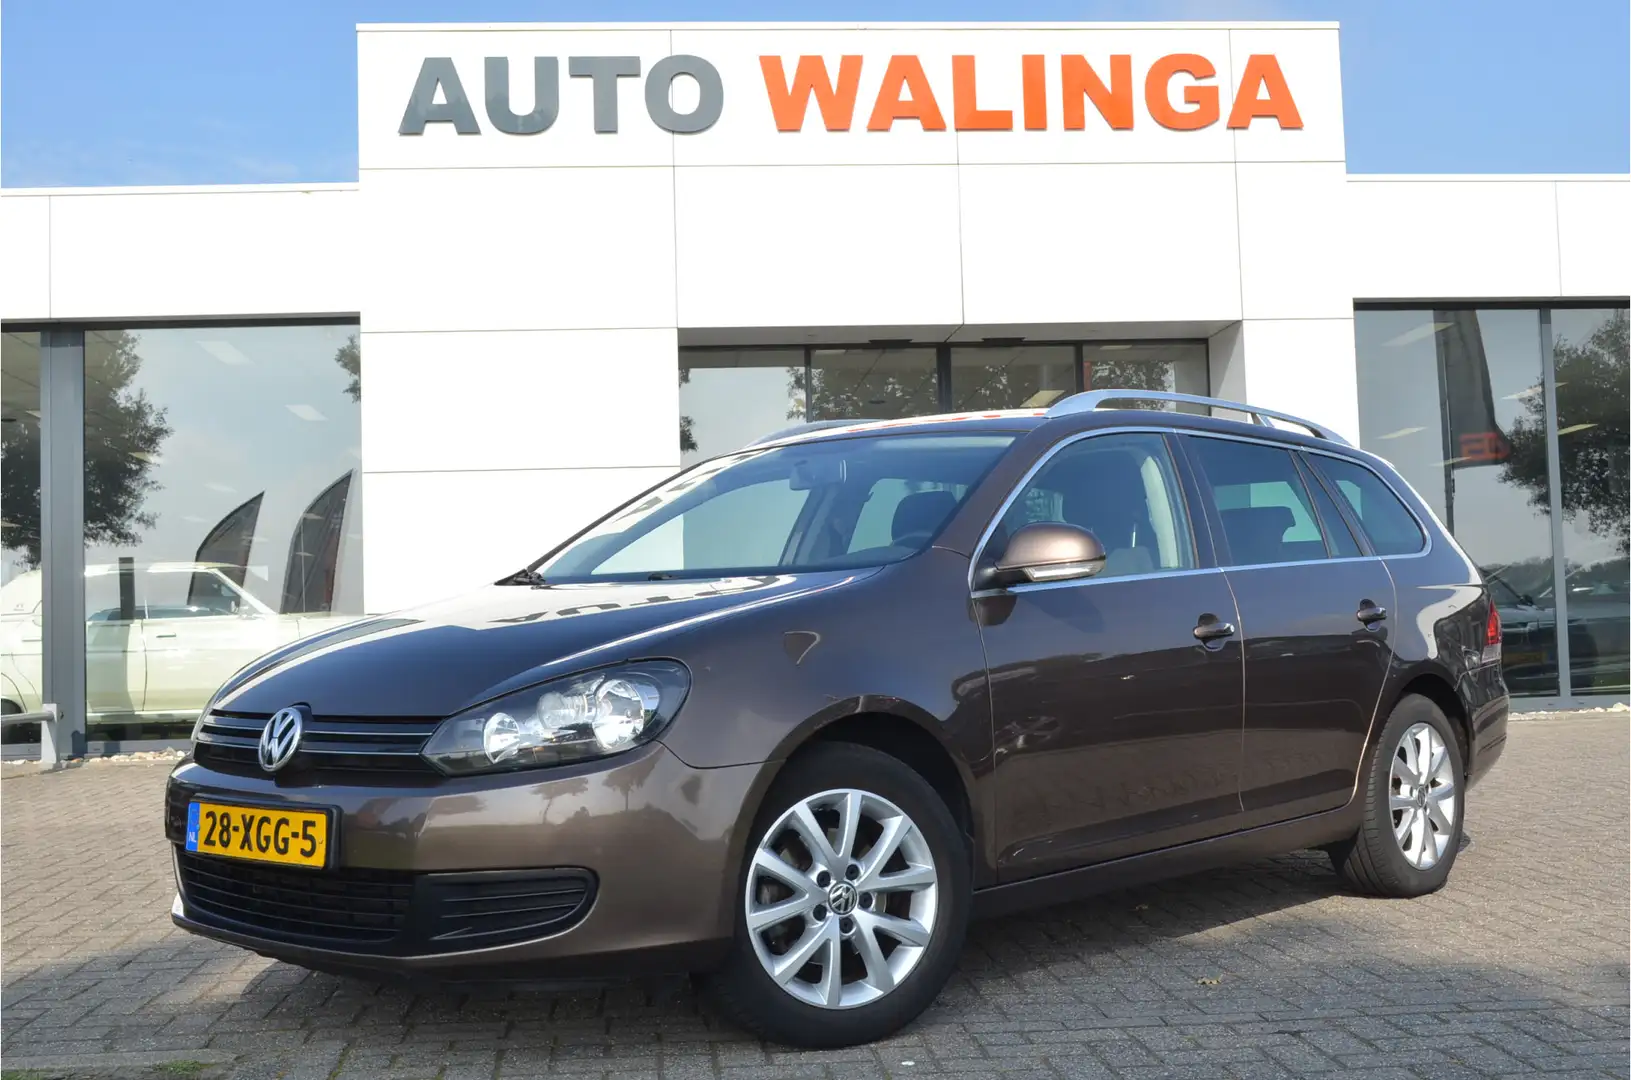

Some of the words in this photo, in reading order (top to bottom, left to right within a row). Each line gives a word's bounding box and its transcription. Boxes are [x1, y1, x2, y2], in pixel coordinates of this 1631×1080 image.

[398, 54, 724, 135] AUTO
[759, 53, 1304, 132] WALINGA
[188, 831, 197, 843] NL
[204, 811, 316, 858] 28-XGG-5
